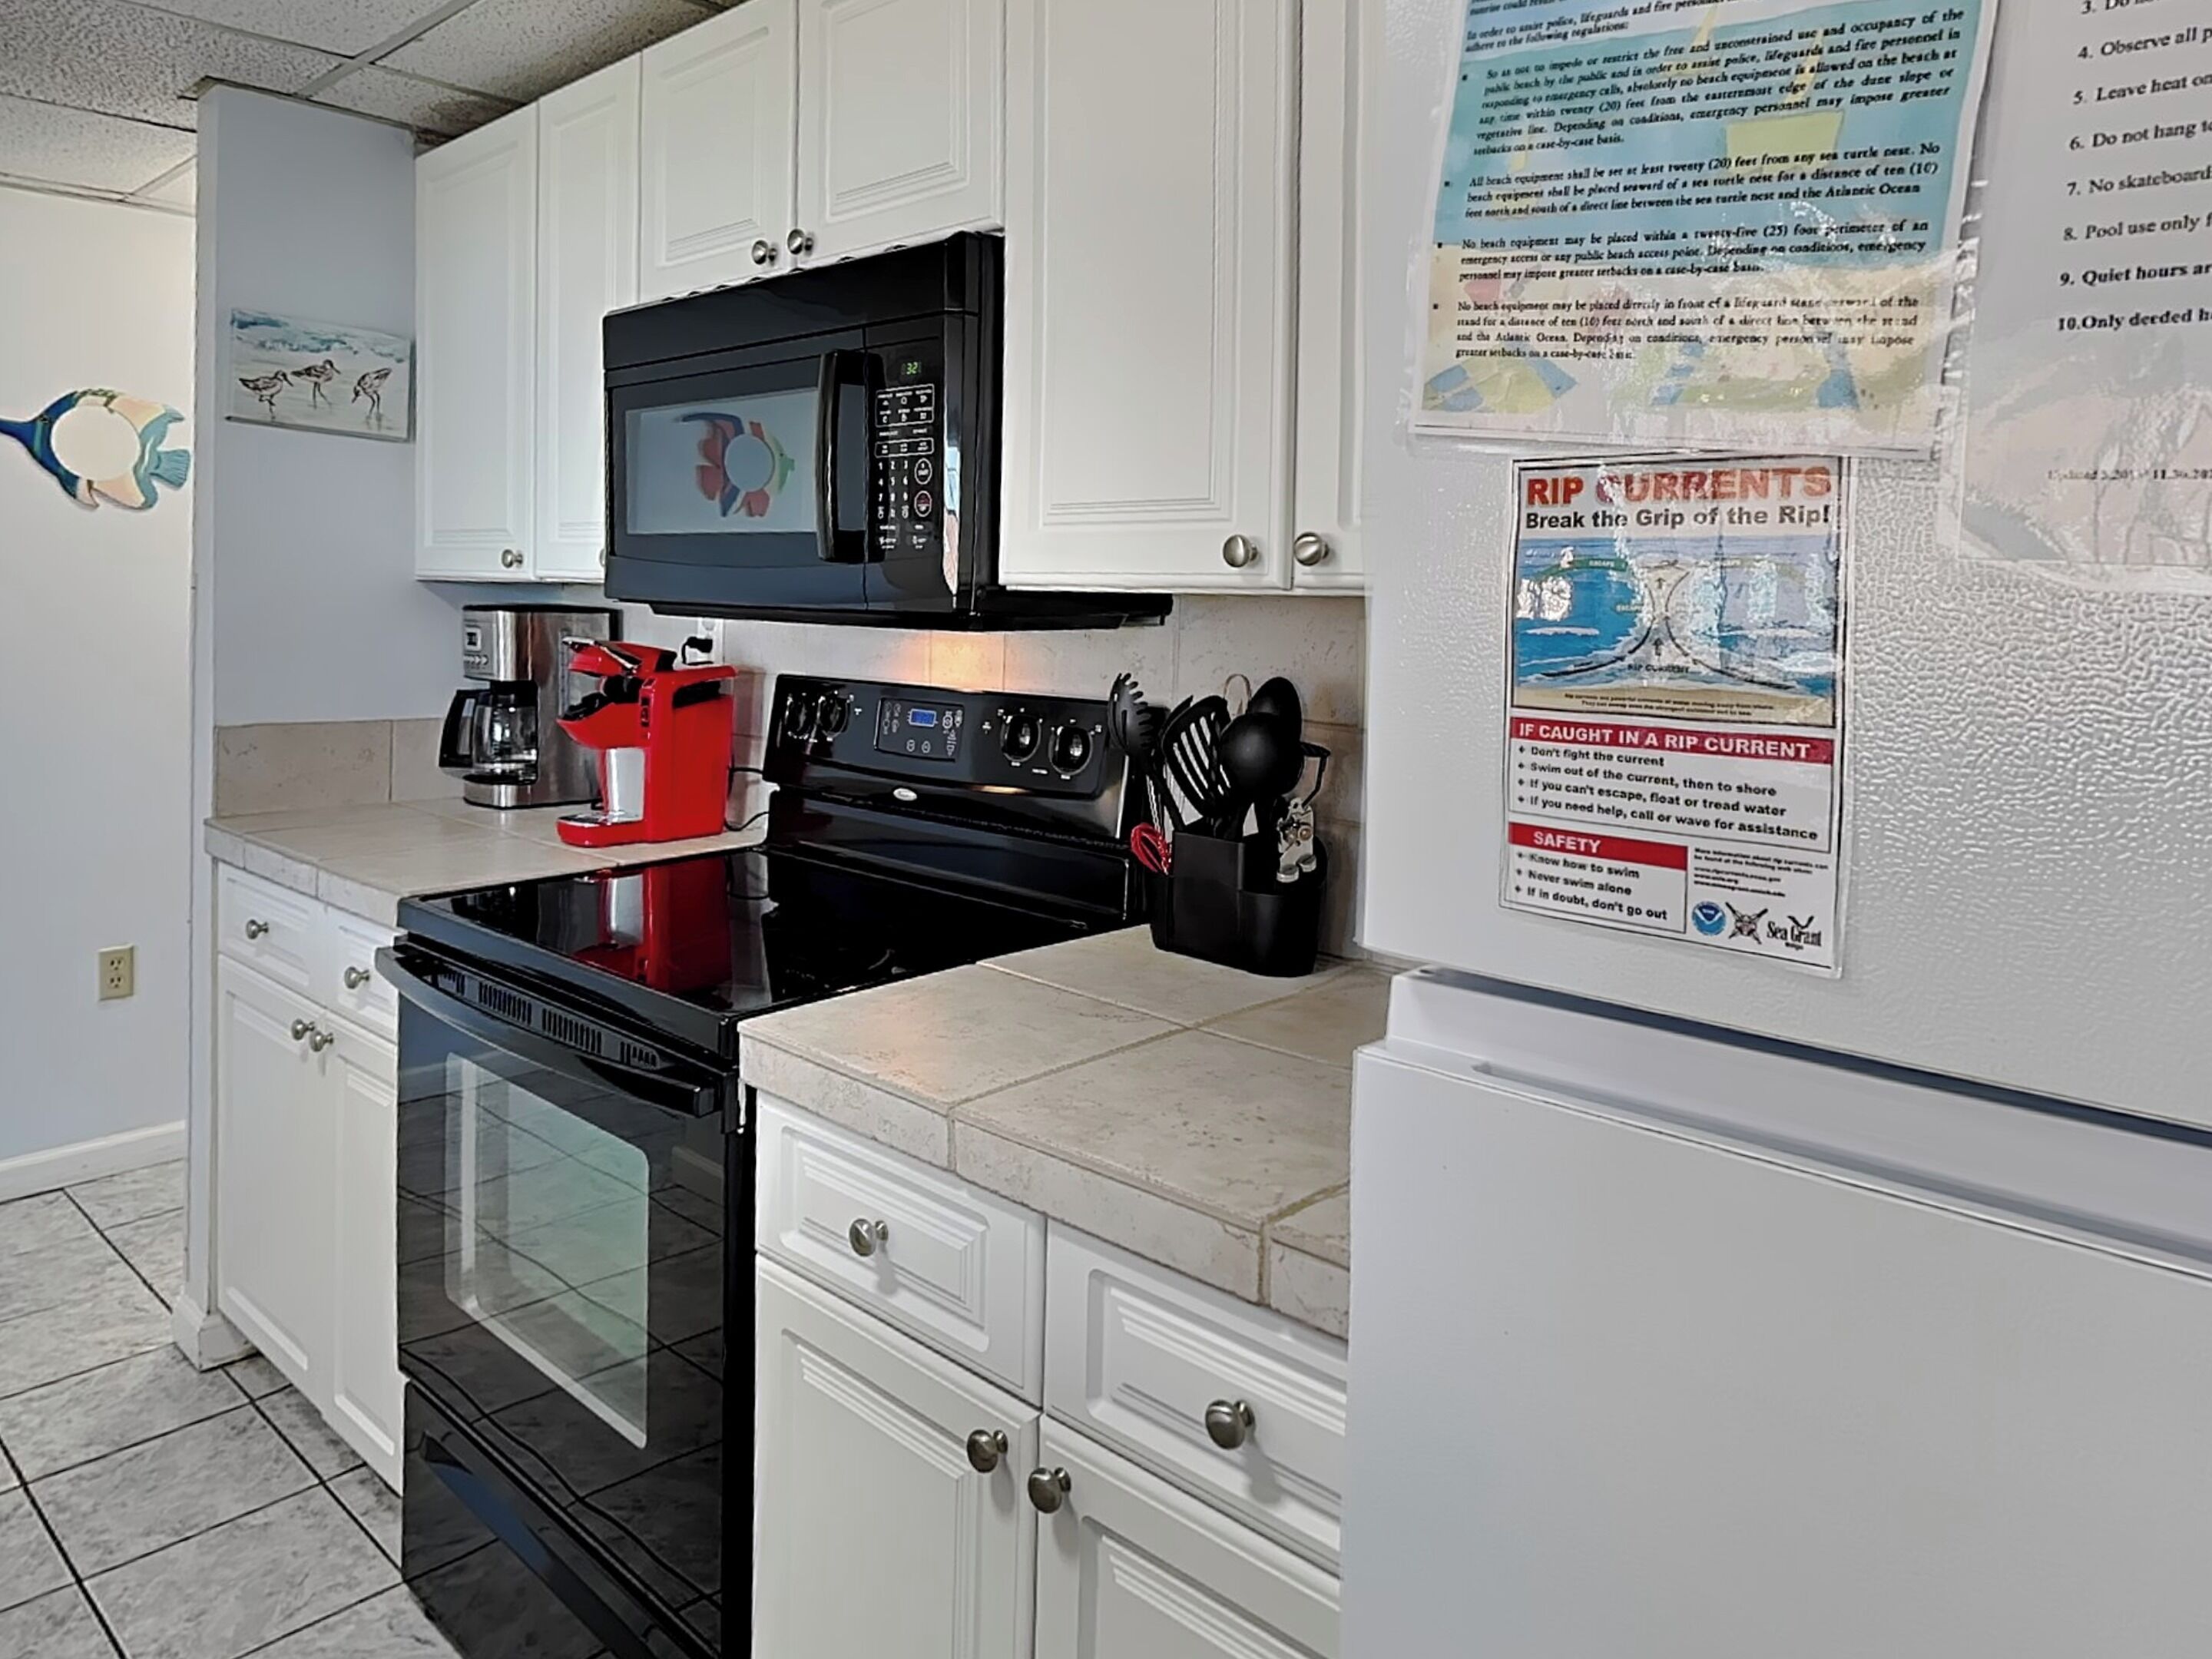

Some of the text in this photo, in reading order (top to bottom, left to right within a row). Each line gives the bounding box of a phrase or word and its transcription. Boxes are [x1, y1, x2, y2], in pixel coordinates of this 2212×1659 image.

[1479, 27, 1503, 38] order
[1506, 26, 1516, 36] to
[1545, 16, 1577, 32] police,
[1580, 6, 1629, 24] lifeguards
[1632, 2, 1651, 15] and
[1654, 0, 1673, 12] fire
[2081, 0, 2129, 15] 3. Do
[1486, 69, 1498, 79] So
[1549, 58, 1583, 71] impede
[1602, 51, 1639, 64] restrict
[1643, 48, 1661, 60] the
[1664, 45, 1685, 56] free
[1690, 39, 1710, 54] and
[1714, 29, 1793, 51] unconstrained
[1797, 30, 1818, 40] use
[1823, 22, 1846, 38] and
[1850, 19, 1916, 33] occupancy
[1922, 12, 1937, 25] of
[1942, 10, 1964, 22] the
[2078, 46, 2093, 59] 4.
[2101, 35, 2171, 56] Observe
[2175, 27, 2197, 44] all
[2096, 84, 2147, 102] Leave
[2151, 76, 2187, 93] heat
[2069, 137, 2085, 151] 6.
[2092, 132, 2118, 147] Do
[2122, 128, 2149, 144] not
[2154, 123, 2197, 138] hang
[1469, 142, 1940, 187] All beach equipment shall be set at least twenty (20) feet from any sea turtle nest. No
[2067, 182, 2081, 196] 7.
[2089, 179, 2114, 194] No
[2064, 227, 2078, 241] 8.
[2085, 221, 2124, 240] Pool
[2128, 222, 2157, 234] use
[2161, 214, 2200, 233] only
[1459, 269, 1502, 283] personnel
[1503, 271, 1523, 283] may
[1524, 265, 1557, 283] impose
[1558, 264, 1594, 280] greater
[1596, 263, 1638, 276] setbacks
[1640, 267, 1654, 276] on
[1655, 267, 1663, 276] a
[1664, 260, 1729, 276] case-by-case
[2059, 272, 2075, 286] 9.
[2082, 268, 2131, 286] Quiet
[2136, 266, 2187, 280] hours
[2058, 313, 2124, 331] 10.Only
[2129, 309, 2192, 326] deeded
[1455, 349, 1488, 359] greater
[1489, 345, 1527, 358] setbacks
[1550, 346, 1608, 363] case-by-case
[906, 362, 918, 375] 32
[1527, 467, 1831, 505] RIP CURRENTS
[1526, 504, 1830, 529] Break the Grip of the Rip!
[1520, 723, 1810, 758] IF CAUGHT IN A RIP CURRENT
[1531, 746, 1664, 767] Don't fight the current
[1530, 763, 1777, 796] Swim out of the current, then to shore
[1530, 779, 1786, 816] If you can't escape, float or tread water
[1530, 796, 1818, 840] If you need help, call or wave for assistance
[1533, 831, 1601, 853] SAFETY
[1528, 853, 1640, 879] Know how to swim
[1528, 870, 1631, 896] Never swim alone
[1527, 887, 1667, 920] If in doubt, don't go out
[1767, 922, 1787, 941] Sea
[1791, 926, 1821, 946] Grant
